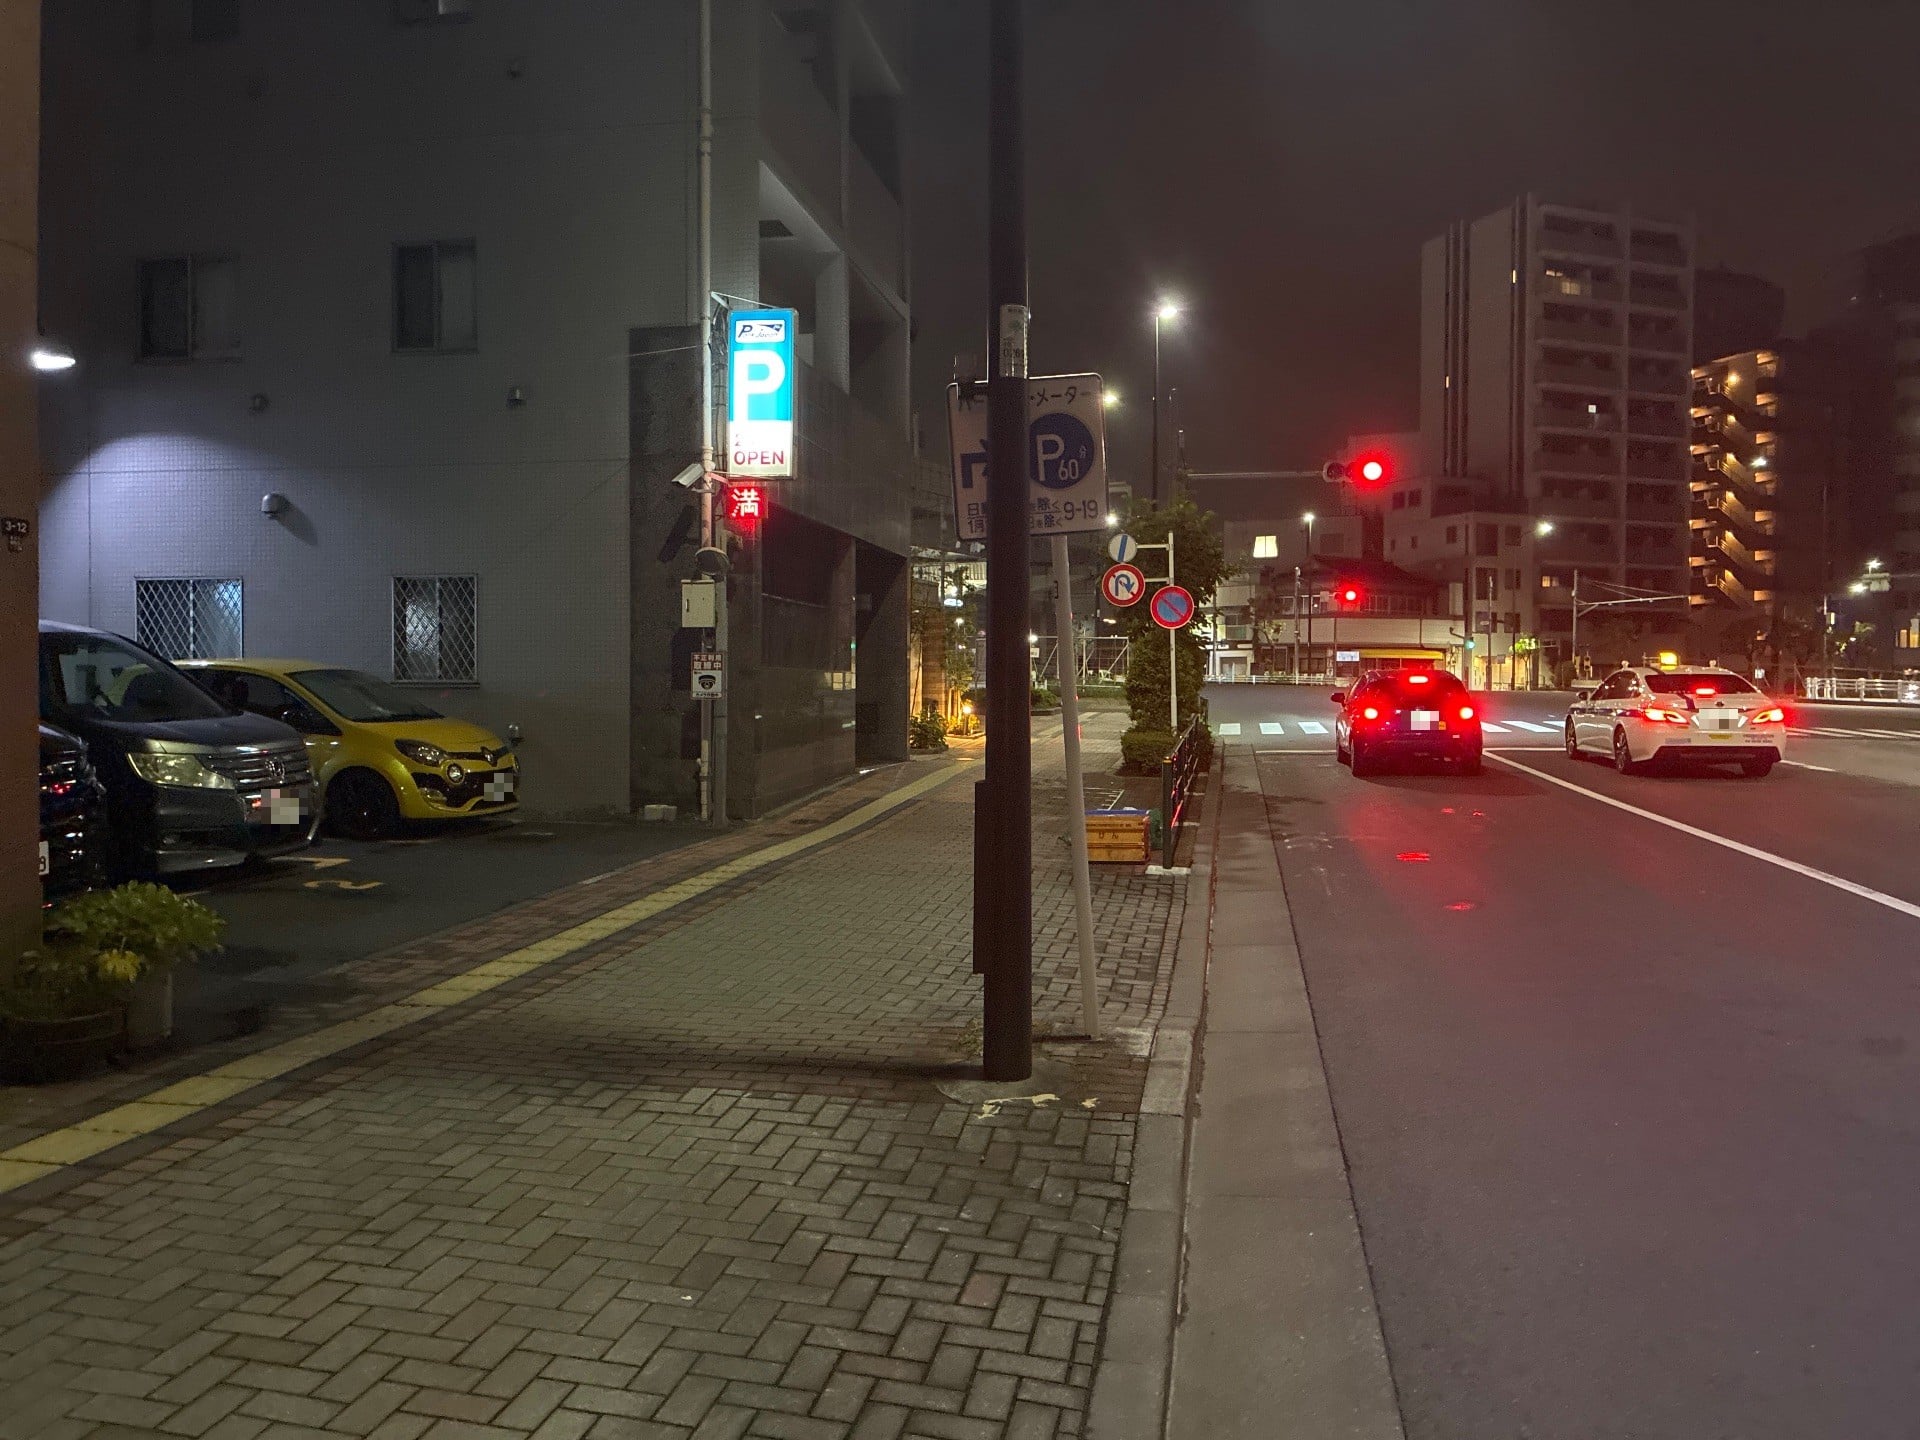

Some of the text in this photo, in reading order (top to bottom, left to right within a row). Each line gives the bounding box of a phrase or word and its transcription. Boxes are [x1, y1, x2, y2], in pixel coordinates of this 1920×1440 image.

[733, 350, 786, 423] P
[733, 451, 785, 466] OPEN
[1036, 434, 1065, 482] P
[1058, 459, 1079, 481] 60
[731, 489, 760, 517] 満
[1063, 500, 1098, 520] 9-19
[5, 520, 27, 533] 3-12
